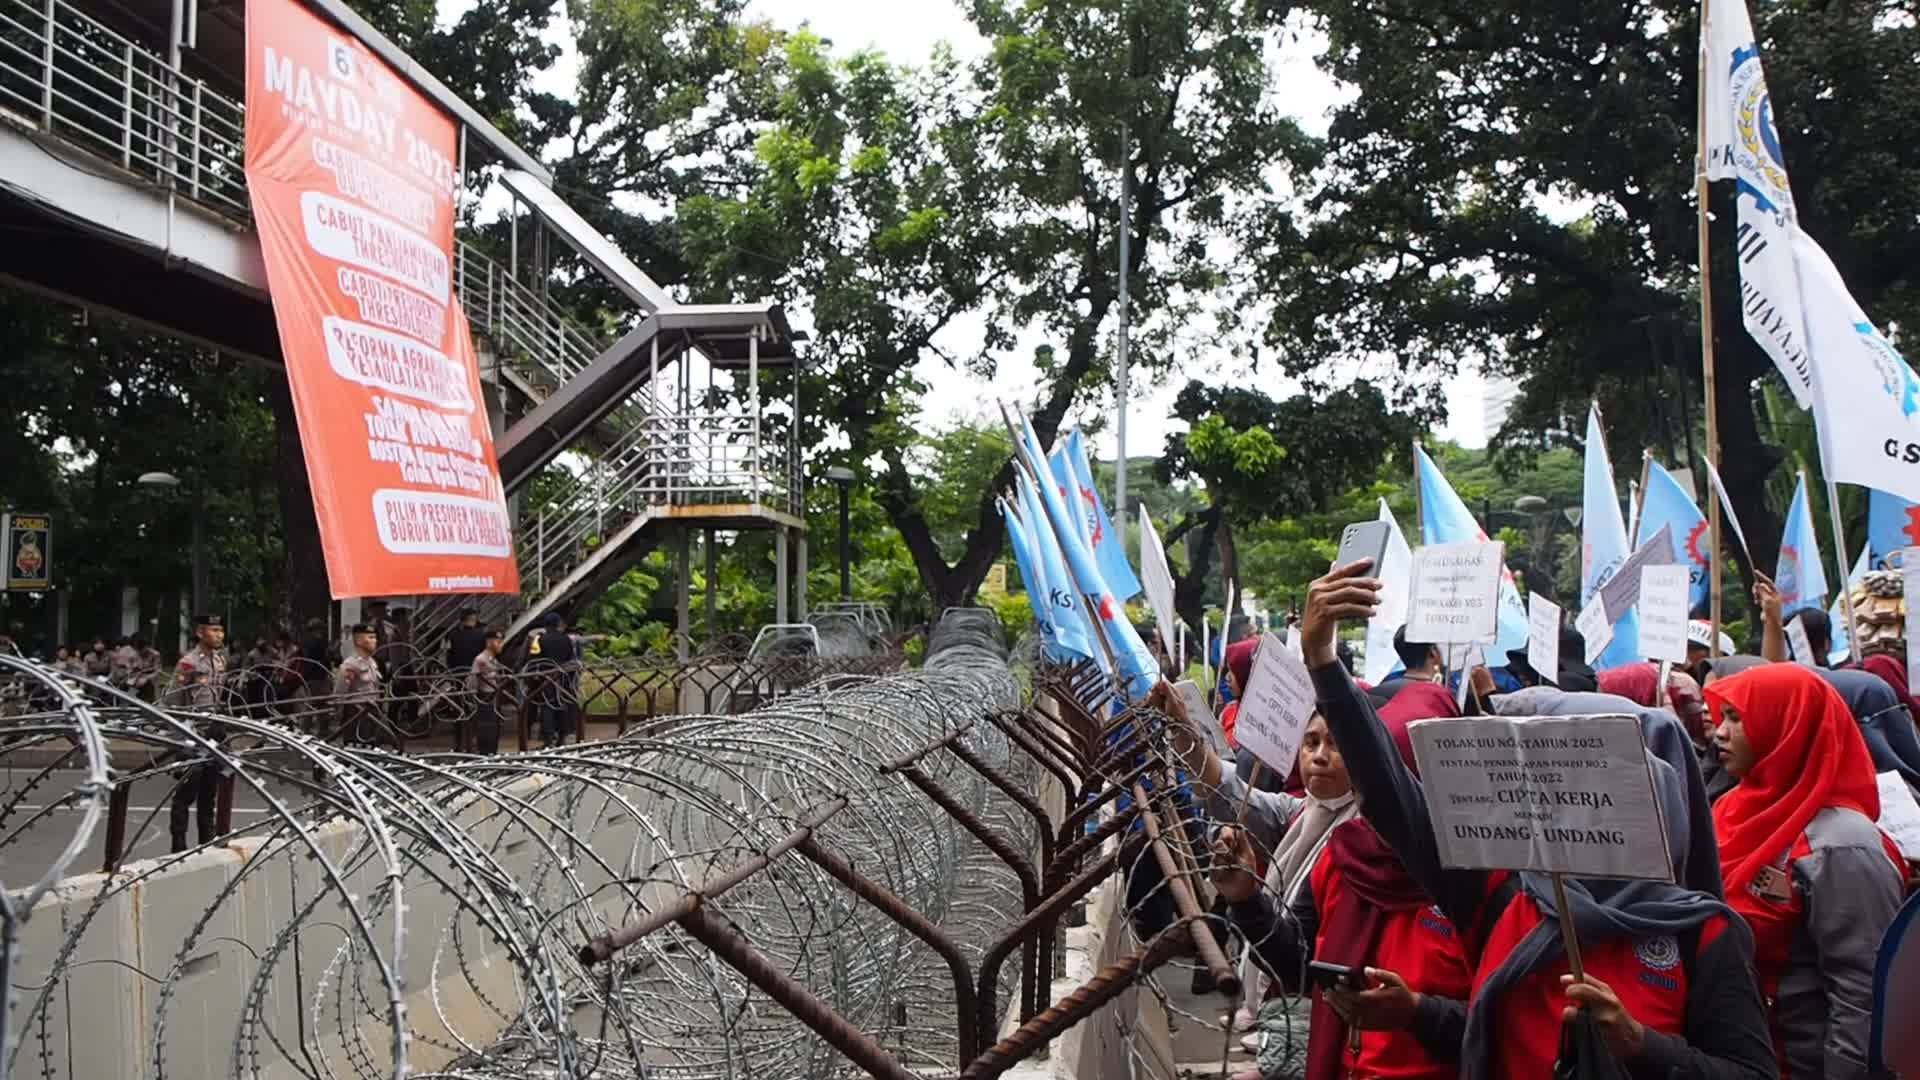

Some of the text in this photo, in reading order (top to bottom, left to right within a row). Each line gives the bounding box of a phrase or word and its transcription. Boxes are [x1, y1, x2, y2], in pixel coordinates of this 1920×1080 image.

[264, 46, 396, 153] MAYDAY
[317, 203, 362, 236] CABUT
[340, 269, 381, 302] CABUT
[385, 500, 416, 521] PILIH
[420, 503, 468, 525] PRESIDEN
[390, 521, 430, 543] BURUH
[433, 522, 455, 544] DAN
[1434, 738, 1475, 749] TOLAK
[1478, 738, 1495, 749] UU
[1523, 739, 1568, 749] TAHUN
[1571, 738, 1605, 749] 2023
[1531, 772, 1563, 784] 2022
[1497, 789, 1551, 806] CIPTA
[1555, 791, 1614, 809] KERJA
[1453, 825, 1531, 840] UNDANG
[1543, 829, 1625, 845] UNDANG
